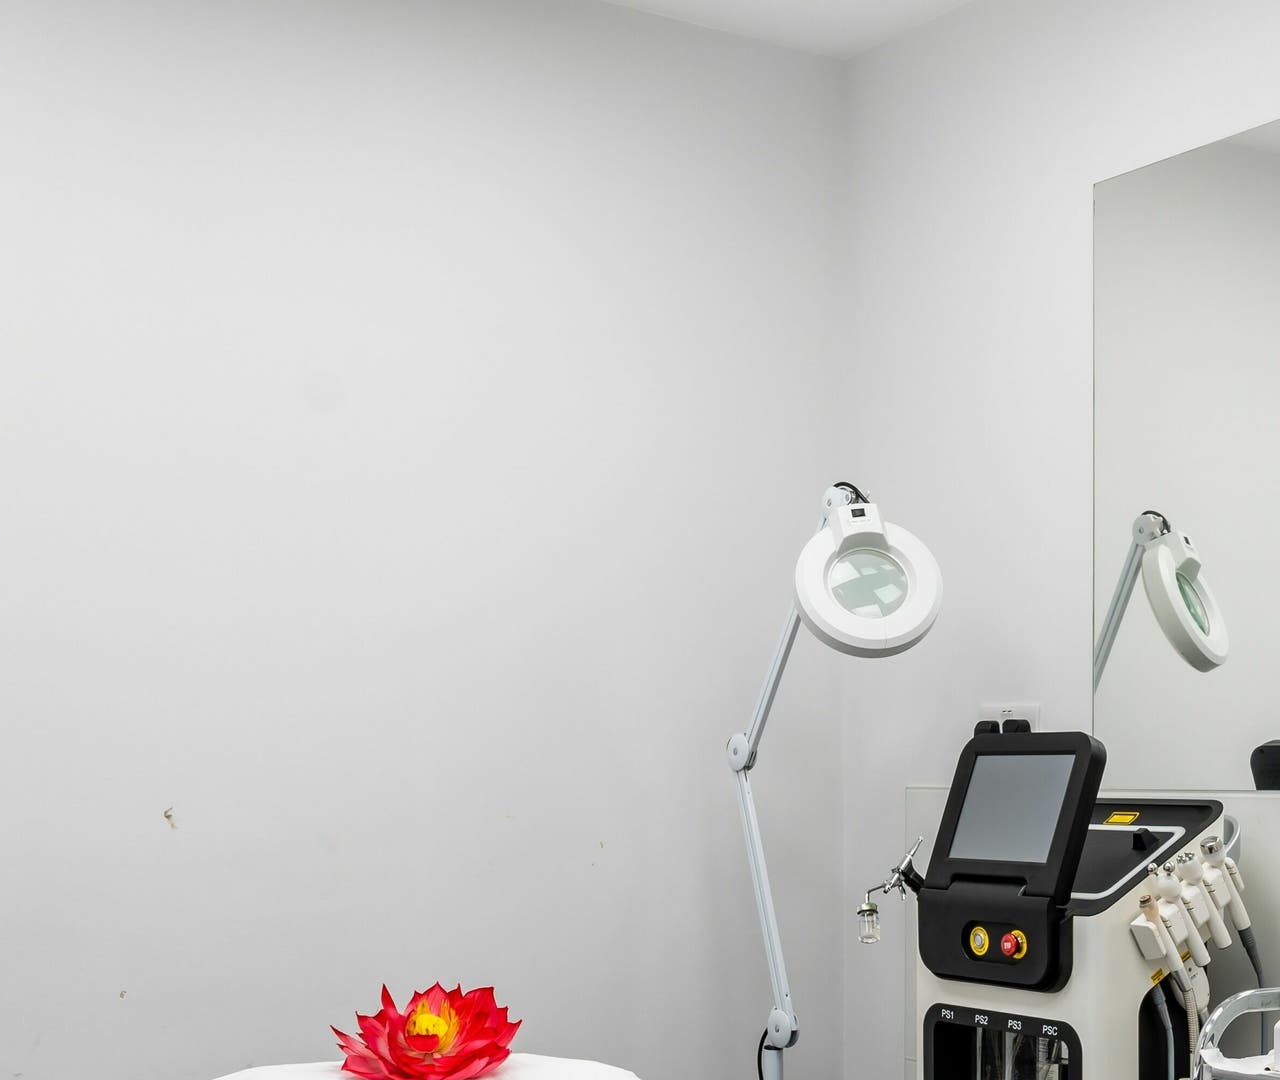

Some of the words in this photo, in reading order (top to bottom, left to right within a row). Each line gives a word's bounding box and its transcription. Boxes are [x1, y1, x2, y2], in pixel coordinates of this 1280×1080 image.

[941, 1009, 954, 1020] PS1
[975, 1014, 988, 1025] PS2
[1008, 1019, 1022, 1030] PS3
[1042, 1025, 1058, 1036] PSC
